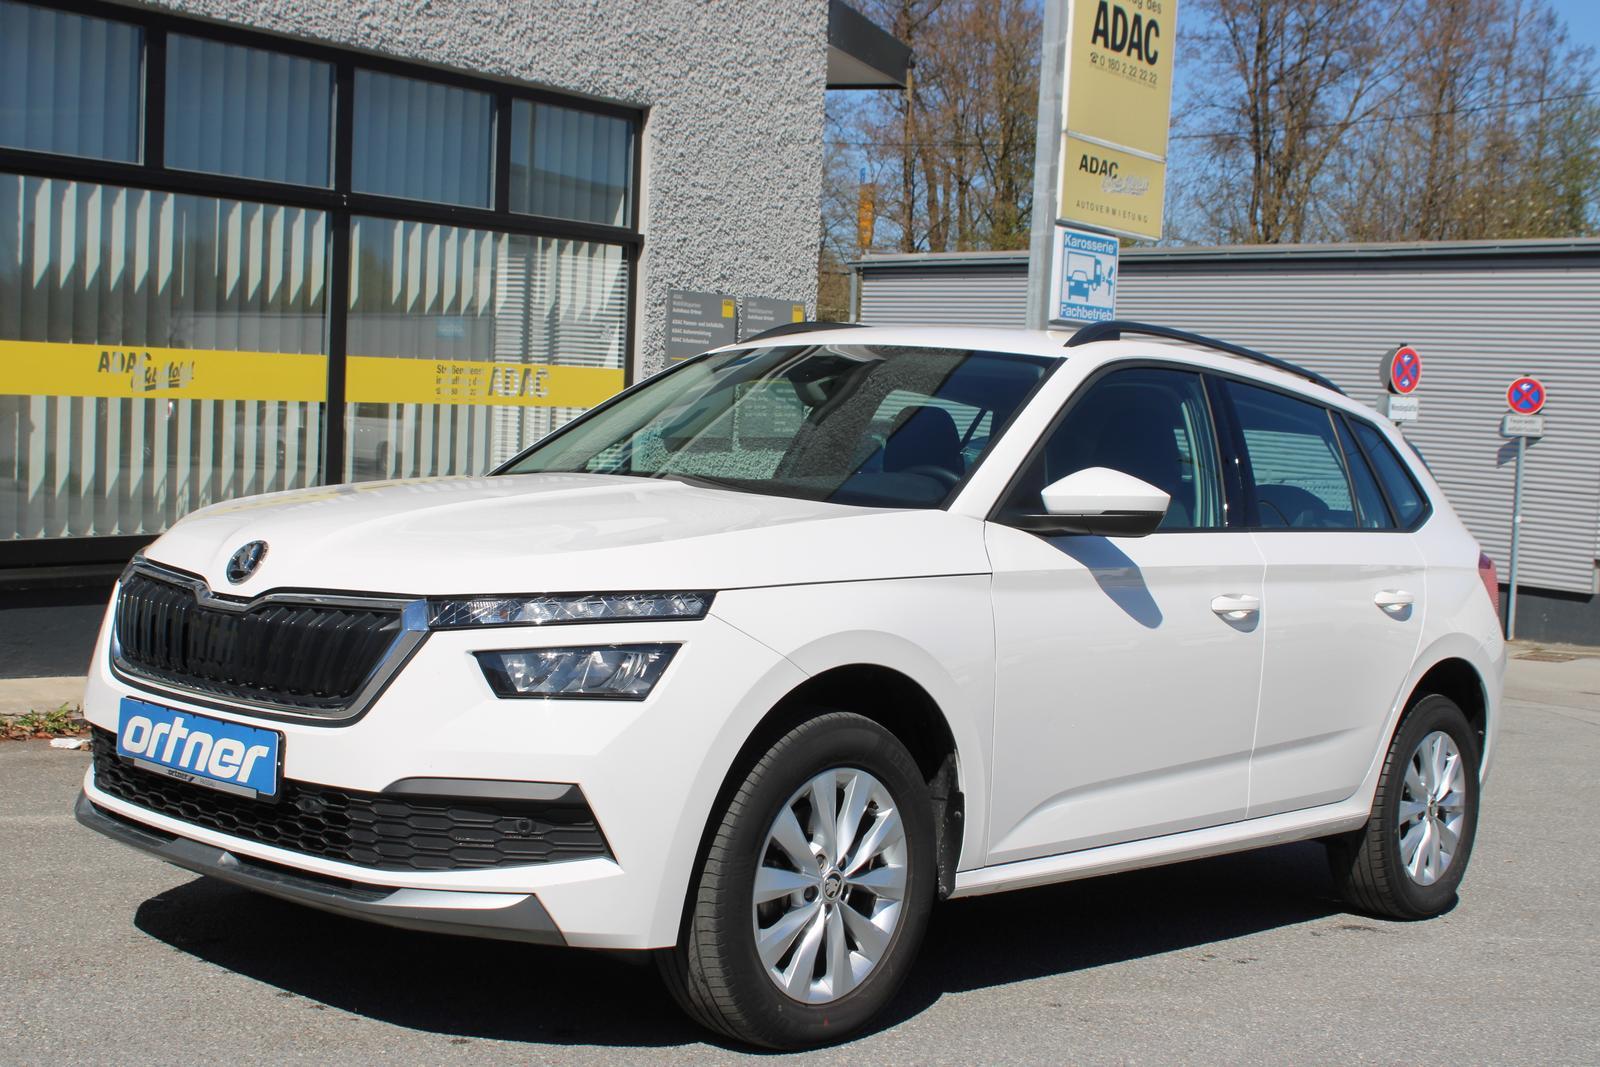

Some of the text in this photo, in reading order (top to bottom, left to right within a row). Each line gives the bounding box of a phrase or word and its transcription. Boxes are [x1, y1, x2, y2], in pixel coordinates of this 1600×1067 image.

[1091, 1, 1160, 66] ADAC
[1079, 154, 1119, 179] ADAC
[1076, 200, 1149, 224] AUTOVERMIETUNG
[1064, 233, 1114, 254] Karosserie
[1060, 303, 1113, 322] Fachbetrieb
[97, 351, 152, 374] ADAC
[488, 366, 550, 398] ADAC
[122, 715, 269, 783] ortner
